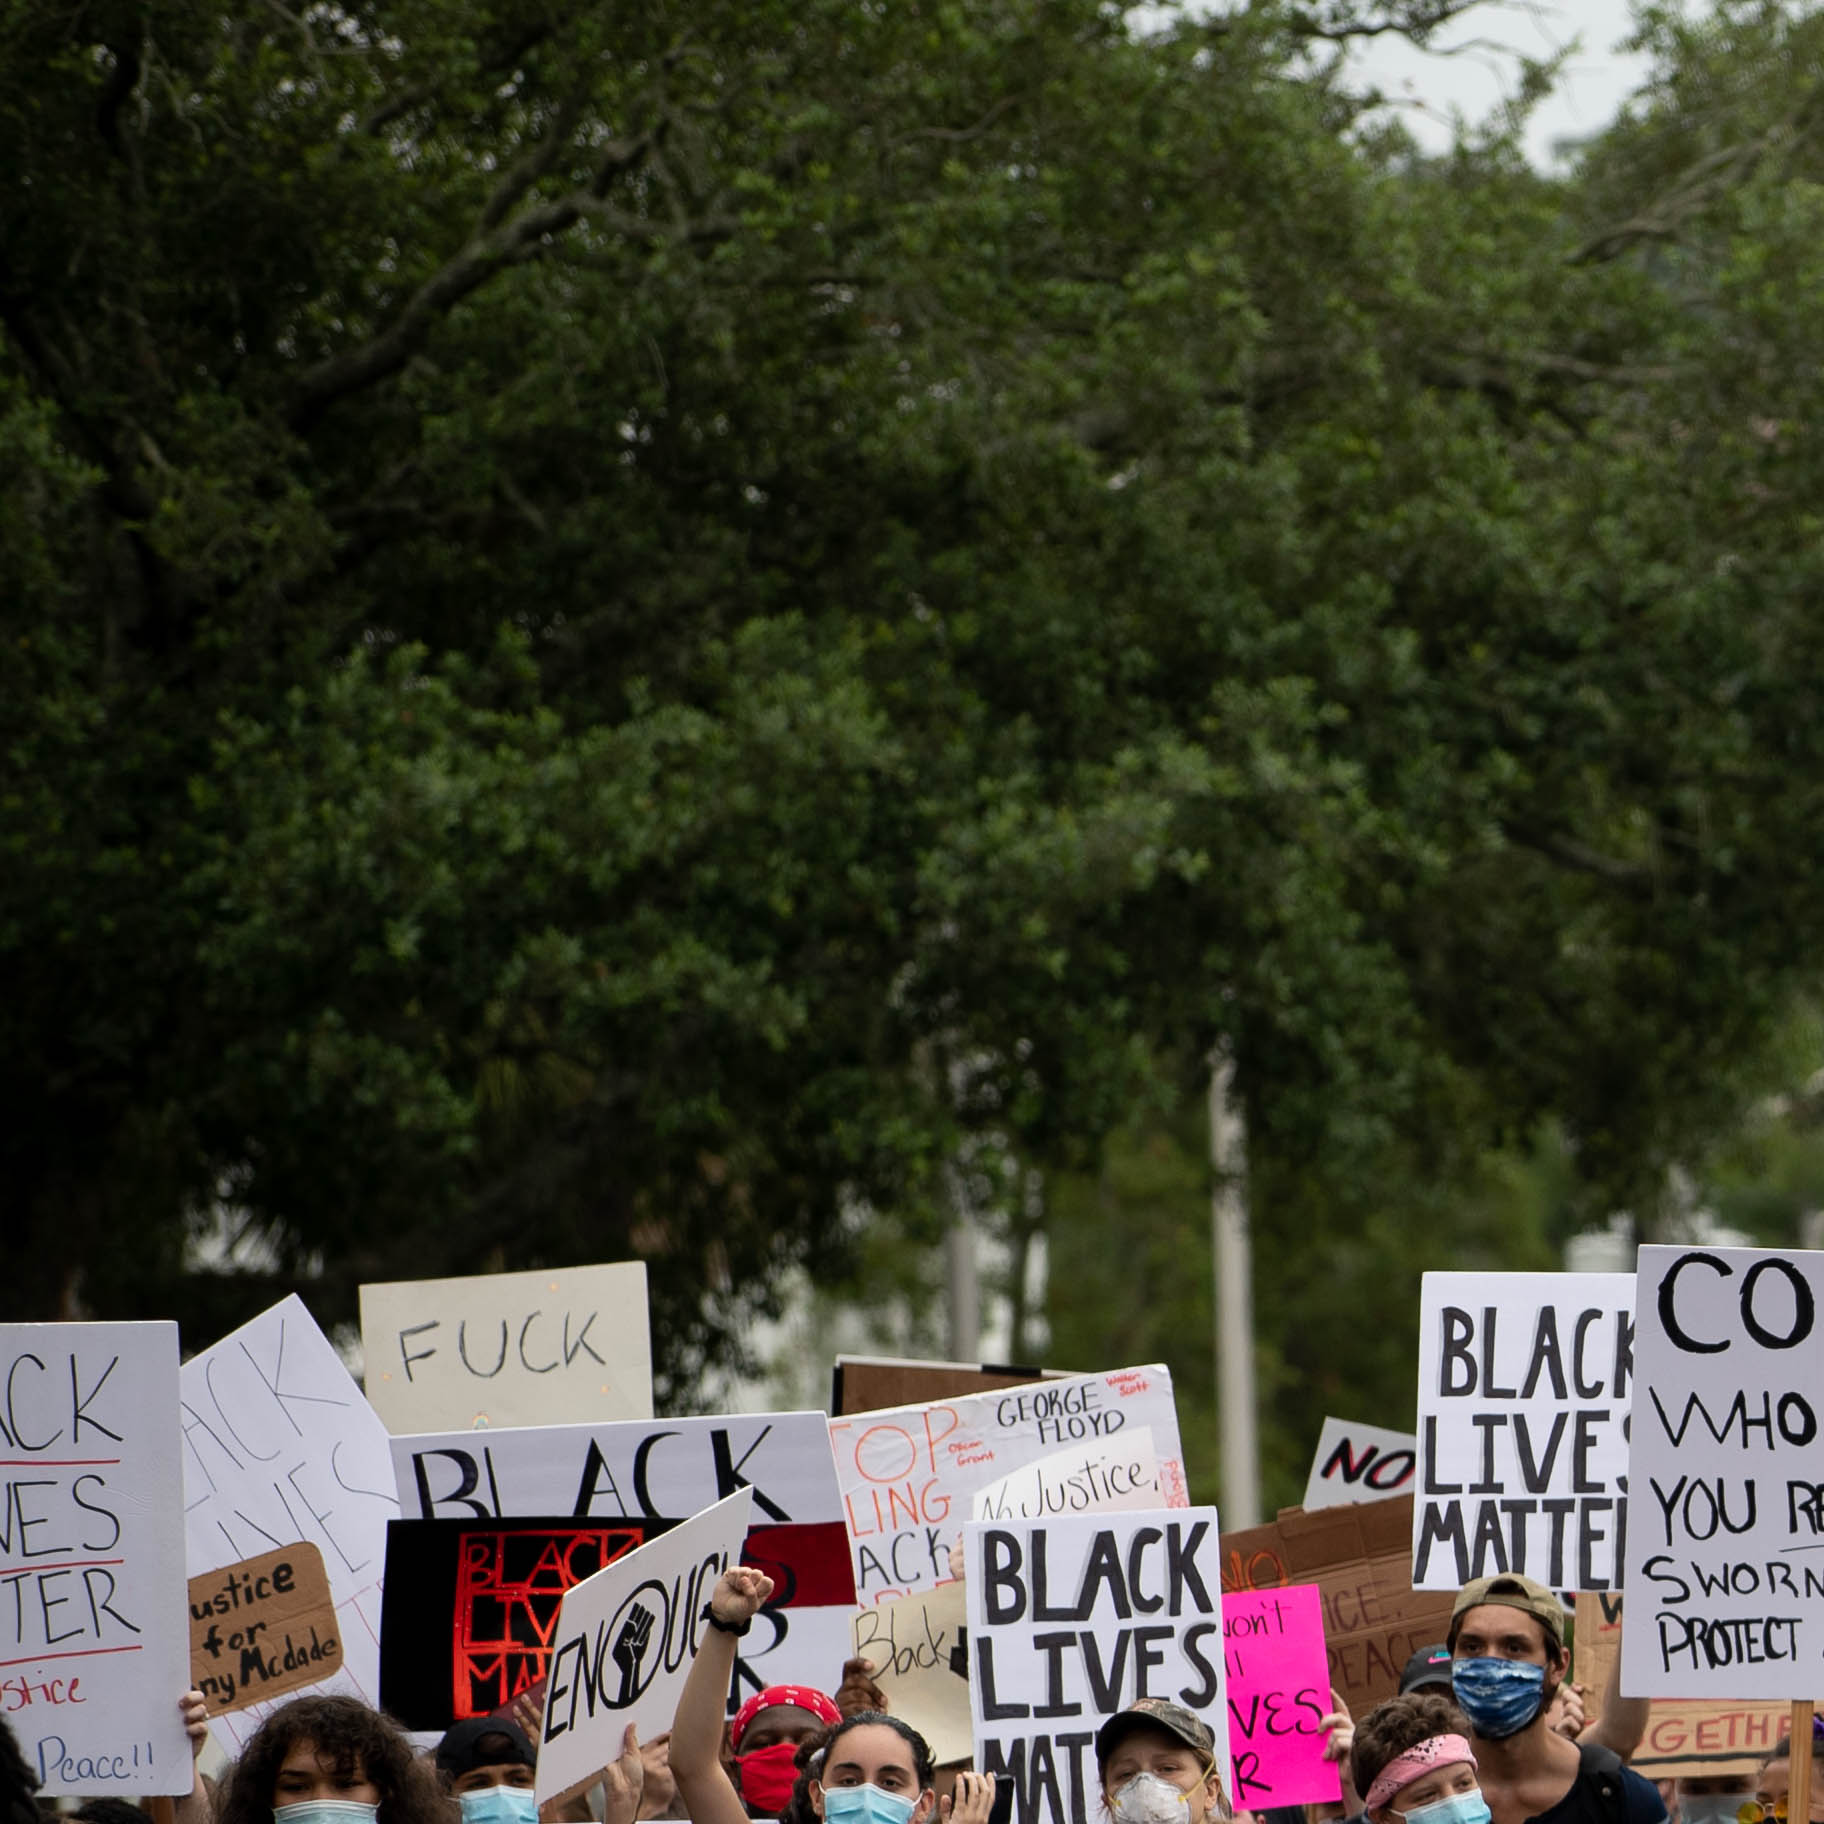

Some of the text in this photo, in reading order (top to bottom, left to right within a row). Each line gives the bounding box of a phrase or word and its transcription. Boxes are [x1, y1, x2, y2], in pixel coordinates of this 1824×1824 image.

[398, 1310, 607, 1382] FUCK
[996, 1381, 1102, 1428] GEORGE
[1037, 1408, 1126, 1445] FLOYD
[1649, 1385, 1818, 1451] WHO
[410, 1422, 793, 1523] BLACK
[956, 1450, 996, 1467] Grant
[1320, 1437, 1417, 1490] NO
[1423, 1409, 1632, 1496] LIVE
[1021, 1456, 1160, 1518] Justice,
[1649, 1474, 1757, 1547] YOU
[981, 1520, 1214, 1626] BLACK
[1411, 1498, 1625, 1591] MATTE
[203, 1620, 268, 1659] for
[239, 1627, 338, 1687] Mcdade
[543, 1550, 730, 1744] ENOUG
[853, 1609, 955, 1681] Black
[1328, 1628, 1432, 1690] EAC
[1655, 1610, 1804, 1673] PROTECT
[975, 1621, 1220, 1723] LIVES
[37, 1734, 154, 1785] Peace!!
[1637, 1710, 1792, 1755] GETH
